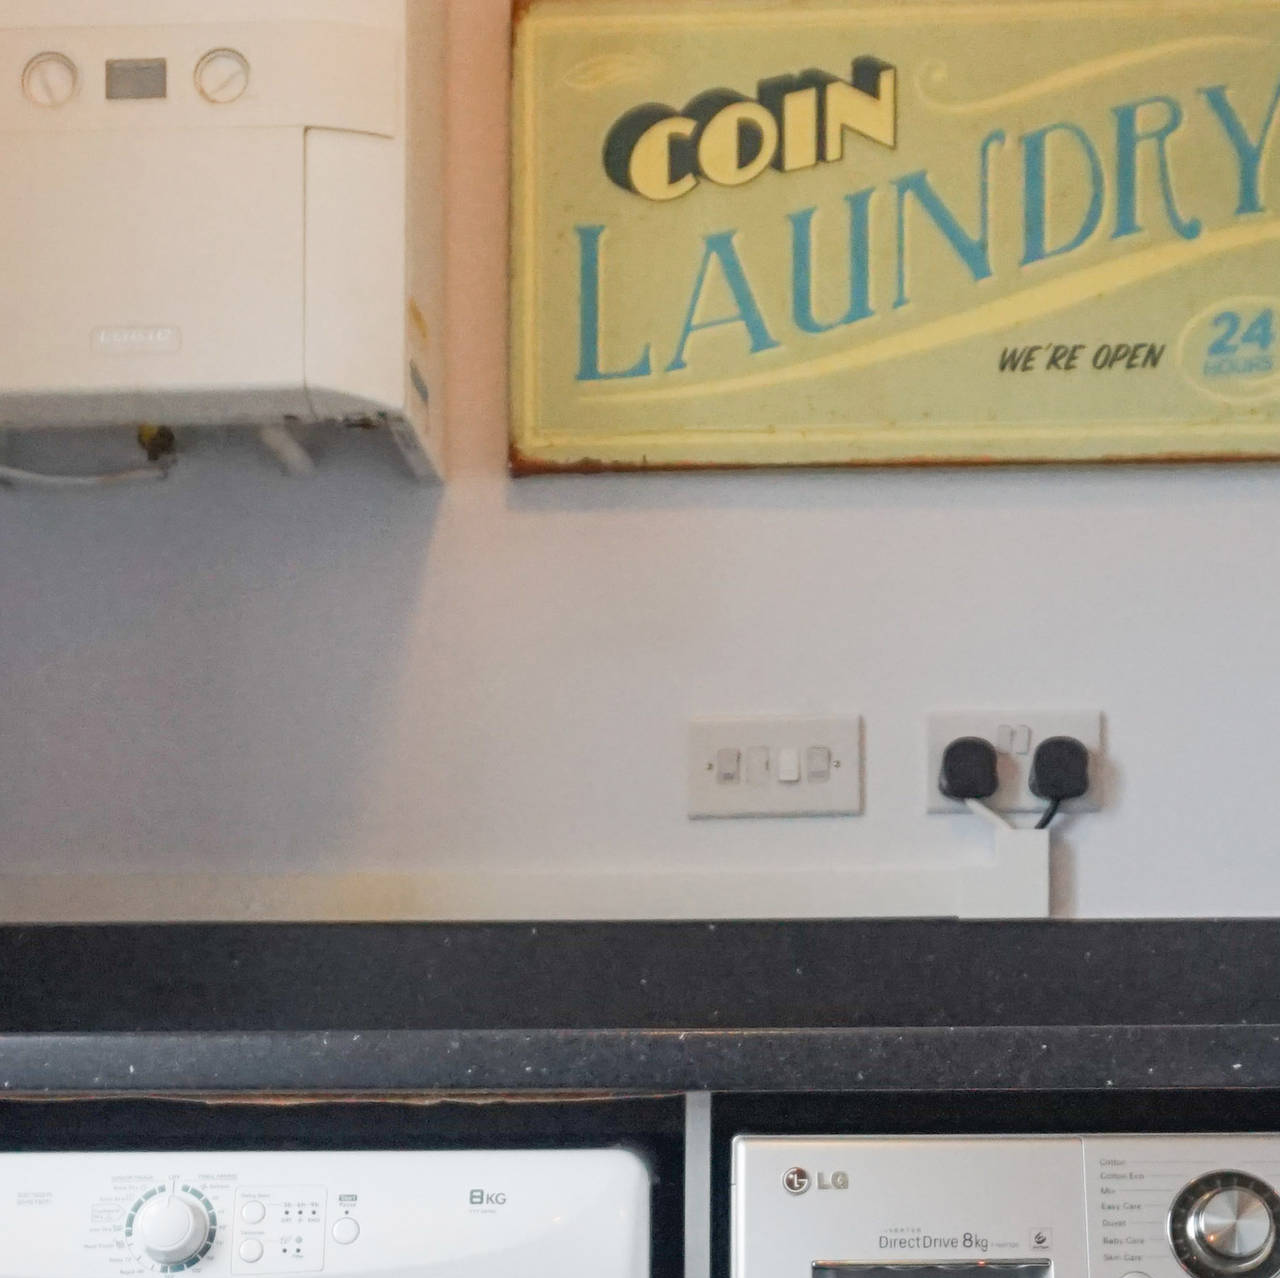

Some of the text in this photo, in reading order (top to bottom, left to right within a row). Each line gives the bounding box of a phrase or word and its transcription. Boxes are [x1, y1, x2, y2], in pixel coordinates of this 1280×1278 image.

[603, 55, 897, 202] COIN
[1208, 308, 1275, 356] 24
[998, 342, 1166, 373] WE'RE OPEN
[816, 1171, 849, 1190] LG
